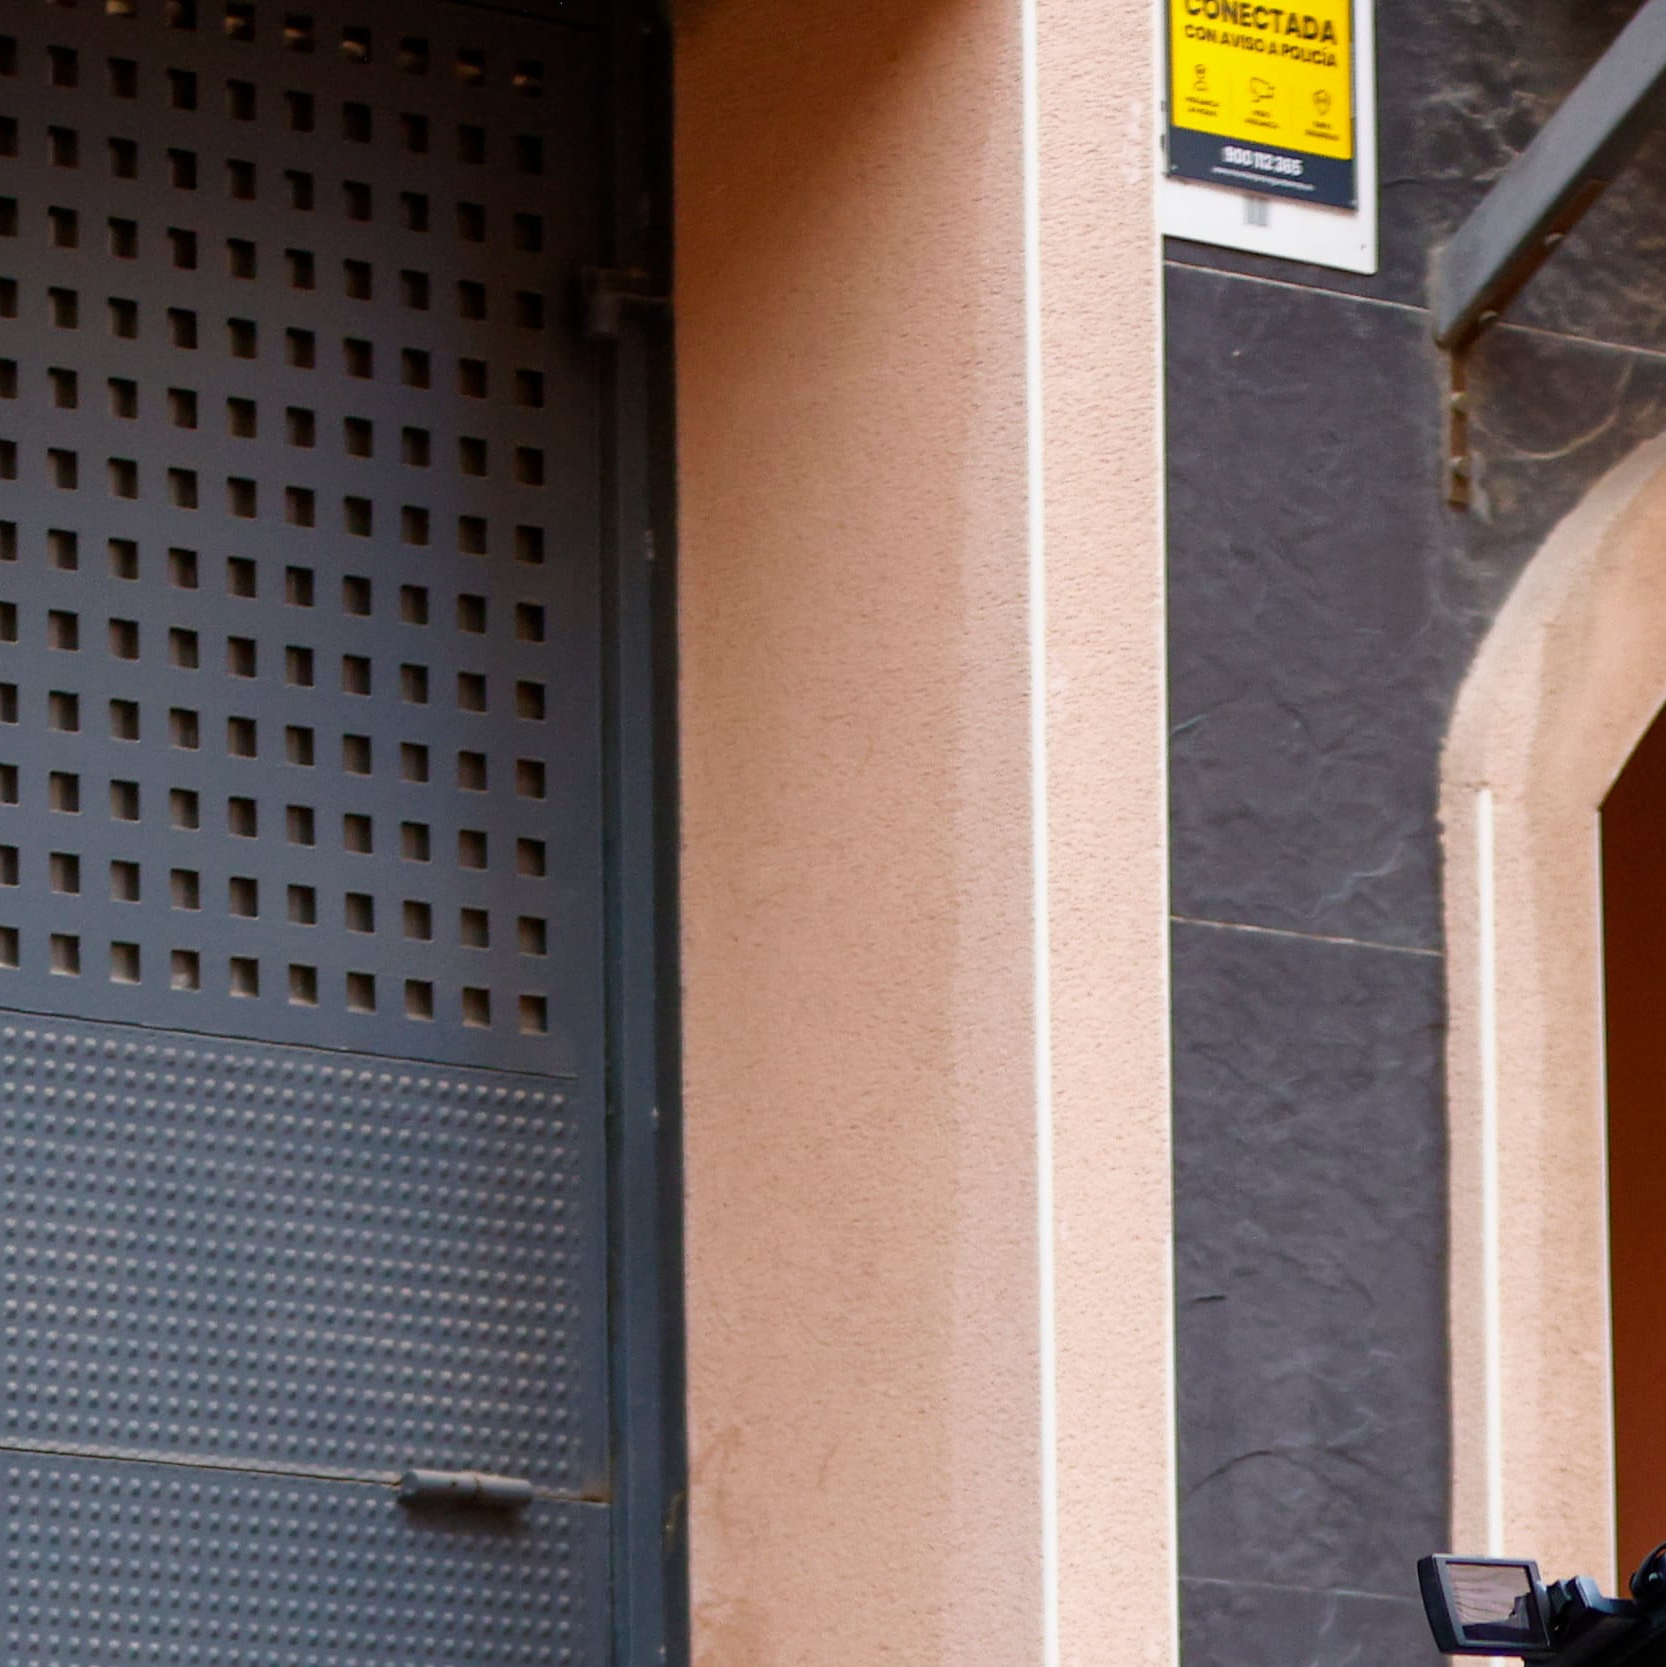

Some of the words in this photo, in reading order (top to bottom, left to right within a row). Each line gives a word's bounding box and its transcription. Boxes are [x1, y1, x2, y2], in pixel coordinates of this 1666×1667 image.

[1185, 0, 1337, 45] CONECTADA
[1184, 24, 1217, 43] CON
[1220, 31, 1264, 53] AVISO
[1268, 42, 1277, 55] A
[1282, 44, 1337, 67] POLICÍA
